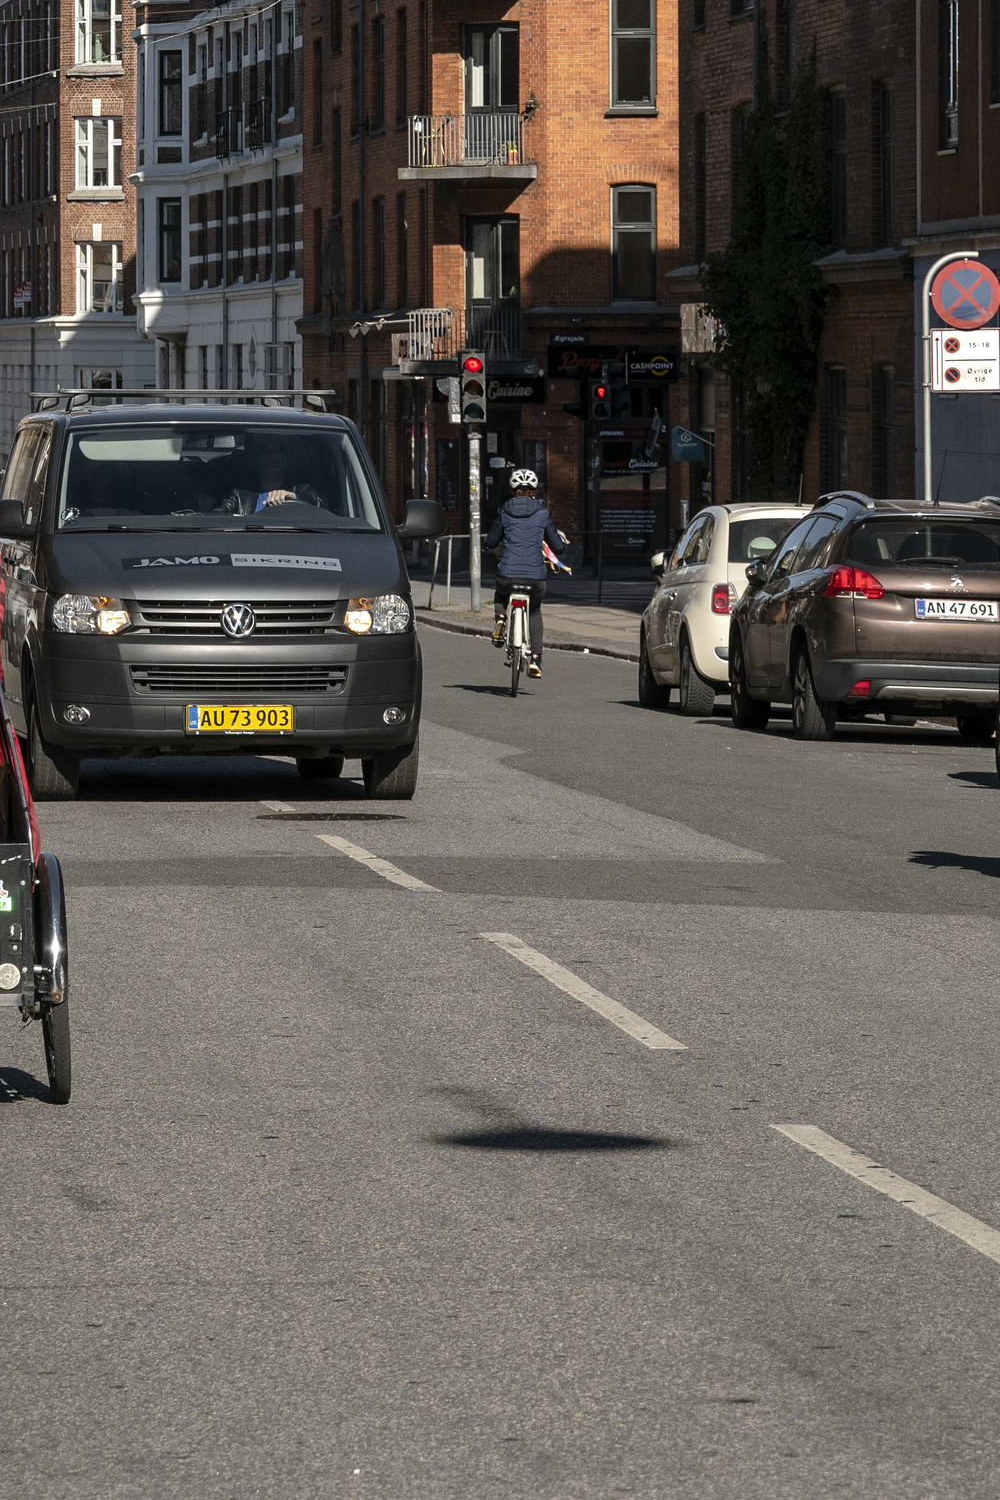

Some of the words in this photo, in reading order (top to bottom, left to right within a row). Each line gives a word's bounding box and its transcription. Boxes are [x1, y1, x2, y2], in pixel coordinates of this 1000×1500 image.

[554, 335, 585, 344] Ægirsgade
[630, 362, 674, 370] CASHPOINT
[487, 380, 534, 400] Cuisine
[628, 458, 659, 469] Cuisine
[132, 556, 220, 568] JAMO
[234, 557, 338, 568] SIKRING
[927, 602, 946, 614] AN
[949, 602, 966, 615] 47
[970, 603, 994, 616] 691
[200, 709, 225, 726] AU
[230, 709, 251, 726] 73
[256, 709, 289, 727] 903
